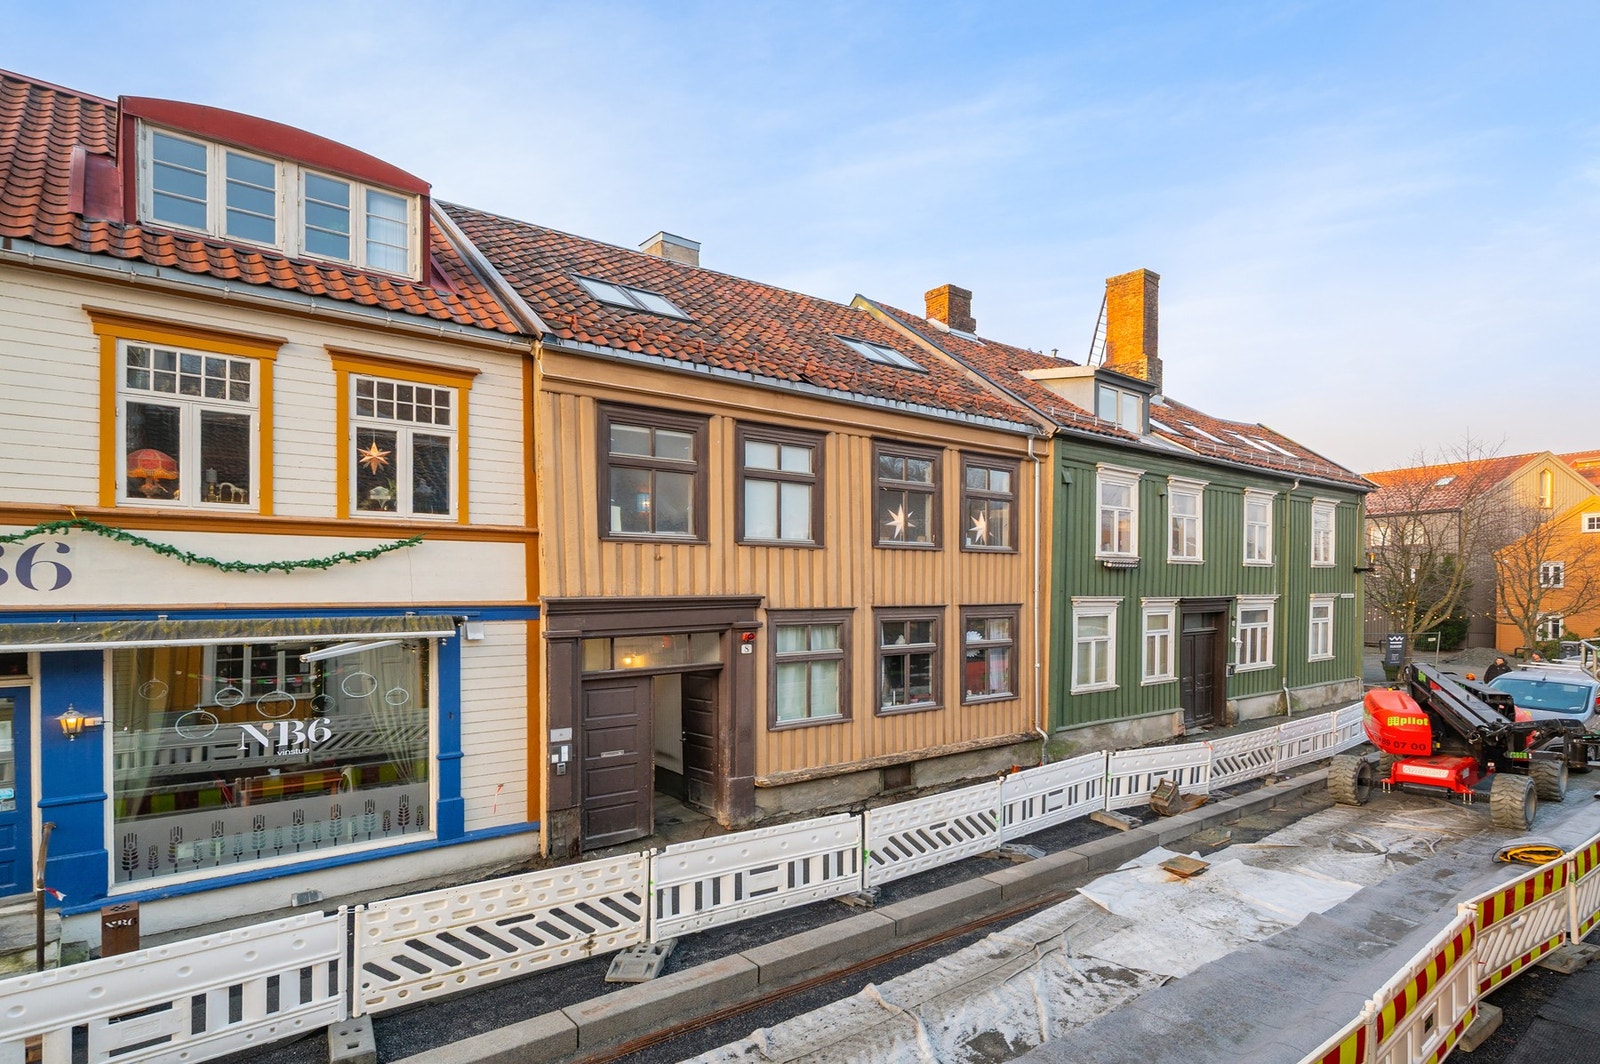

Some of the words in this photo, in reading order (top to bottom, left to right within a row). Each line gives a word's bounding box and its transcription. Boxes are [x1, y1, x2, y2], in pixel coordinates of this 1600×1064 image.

[0, 541, 73, 592] 6
[1400, 716, 1429, 726] pilot
[237, 718, 332, 750] NB6
[1393, 740, 1407, 749] 07
[1410, 742, 1427, 751] 00
[277, 747, 310, 756] vinstue
